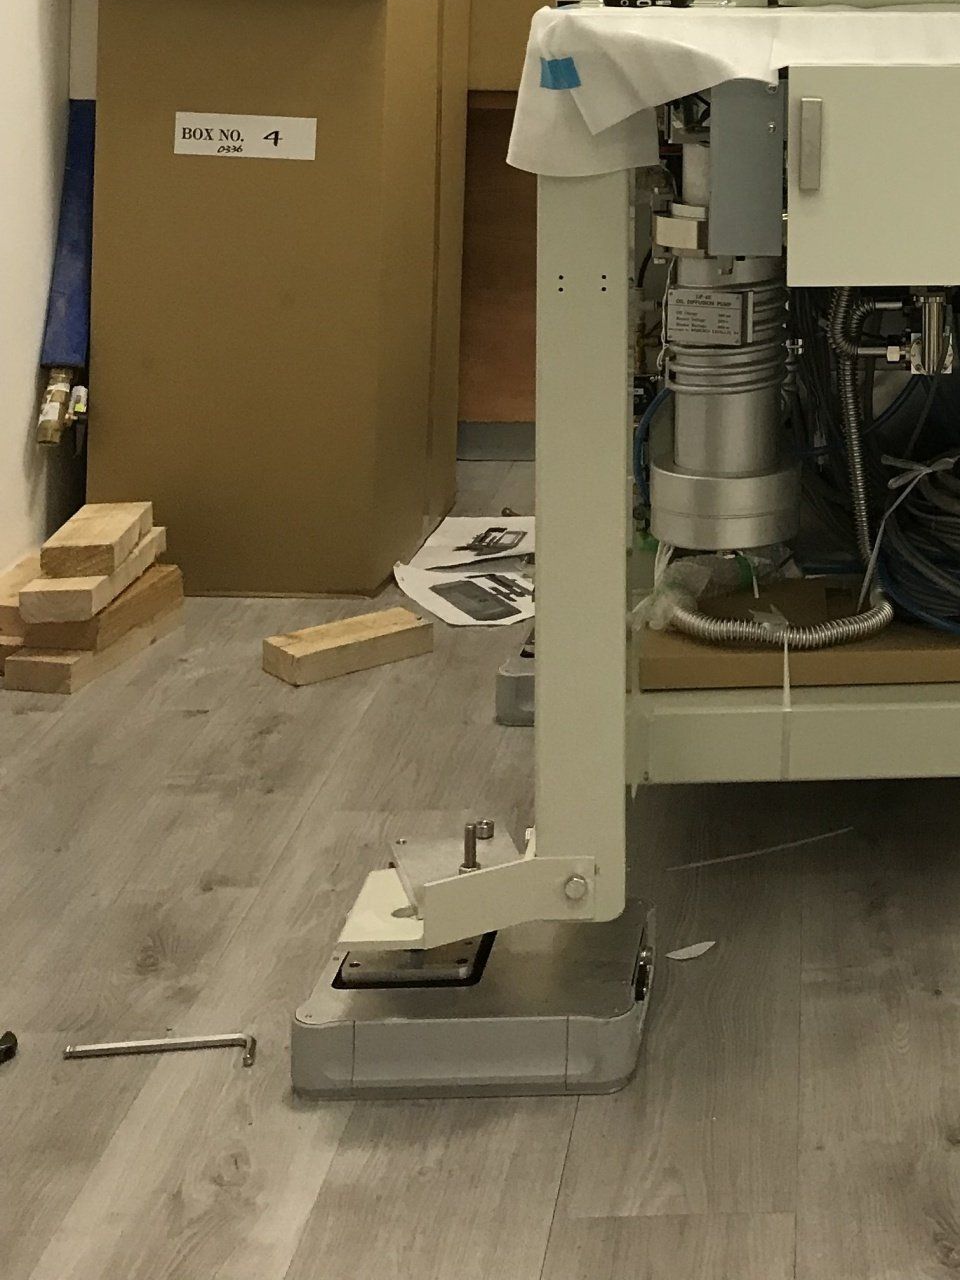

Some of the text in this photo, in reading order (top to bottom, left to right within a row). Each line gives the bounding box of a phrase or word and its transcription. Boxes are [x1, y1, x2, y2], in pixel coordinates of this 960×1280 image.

[181, 127, 283, 147] BOX NO. 4
